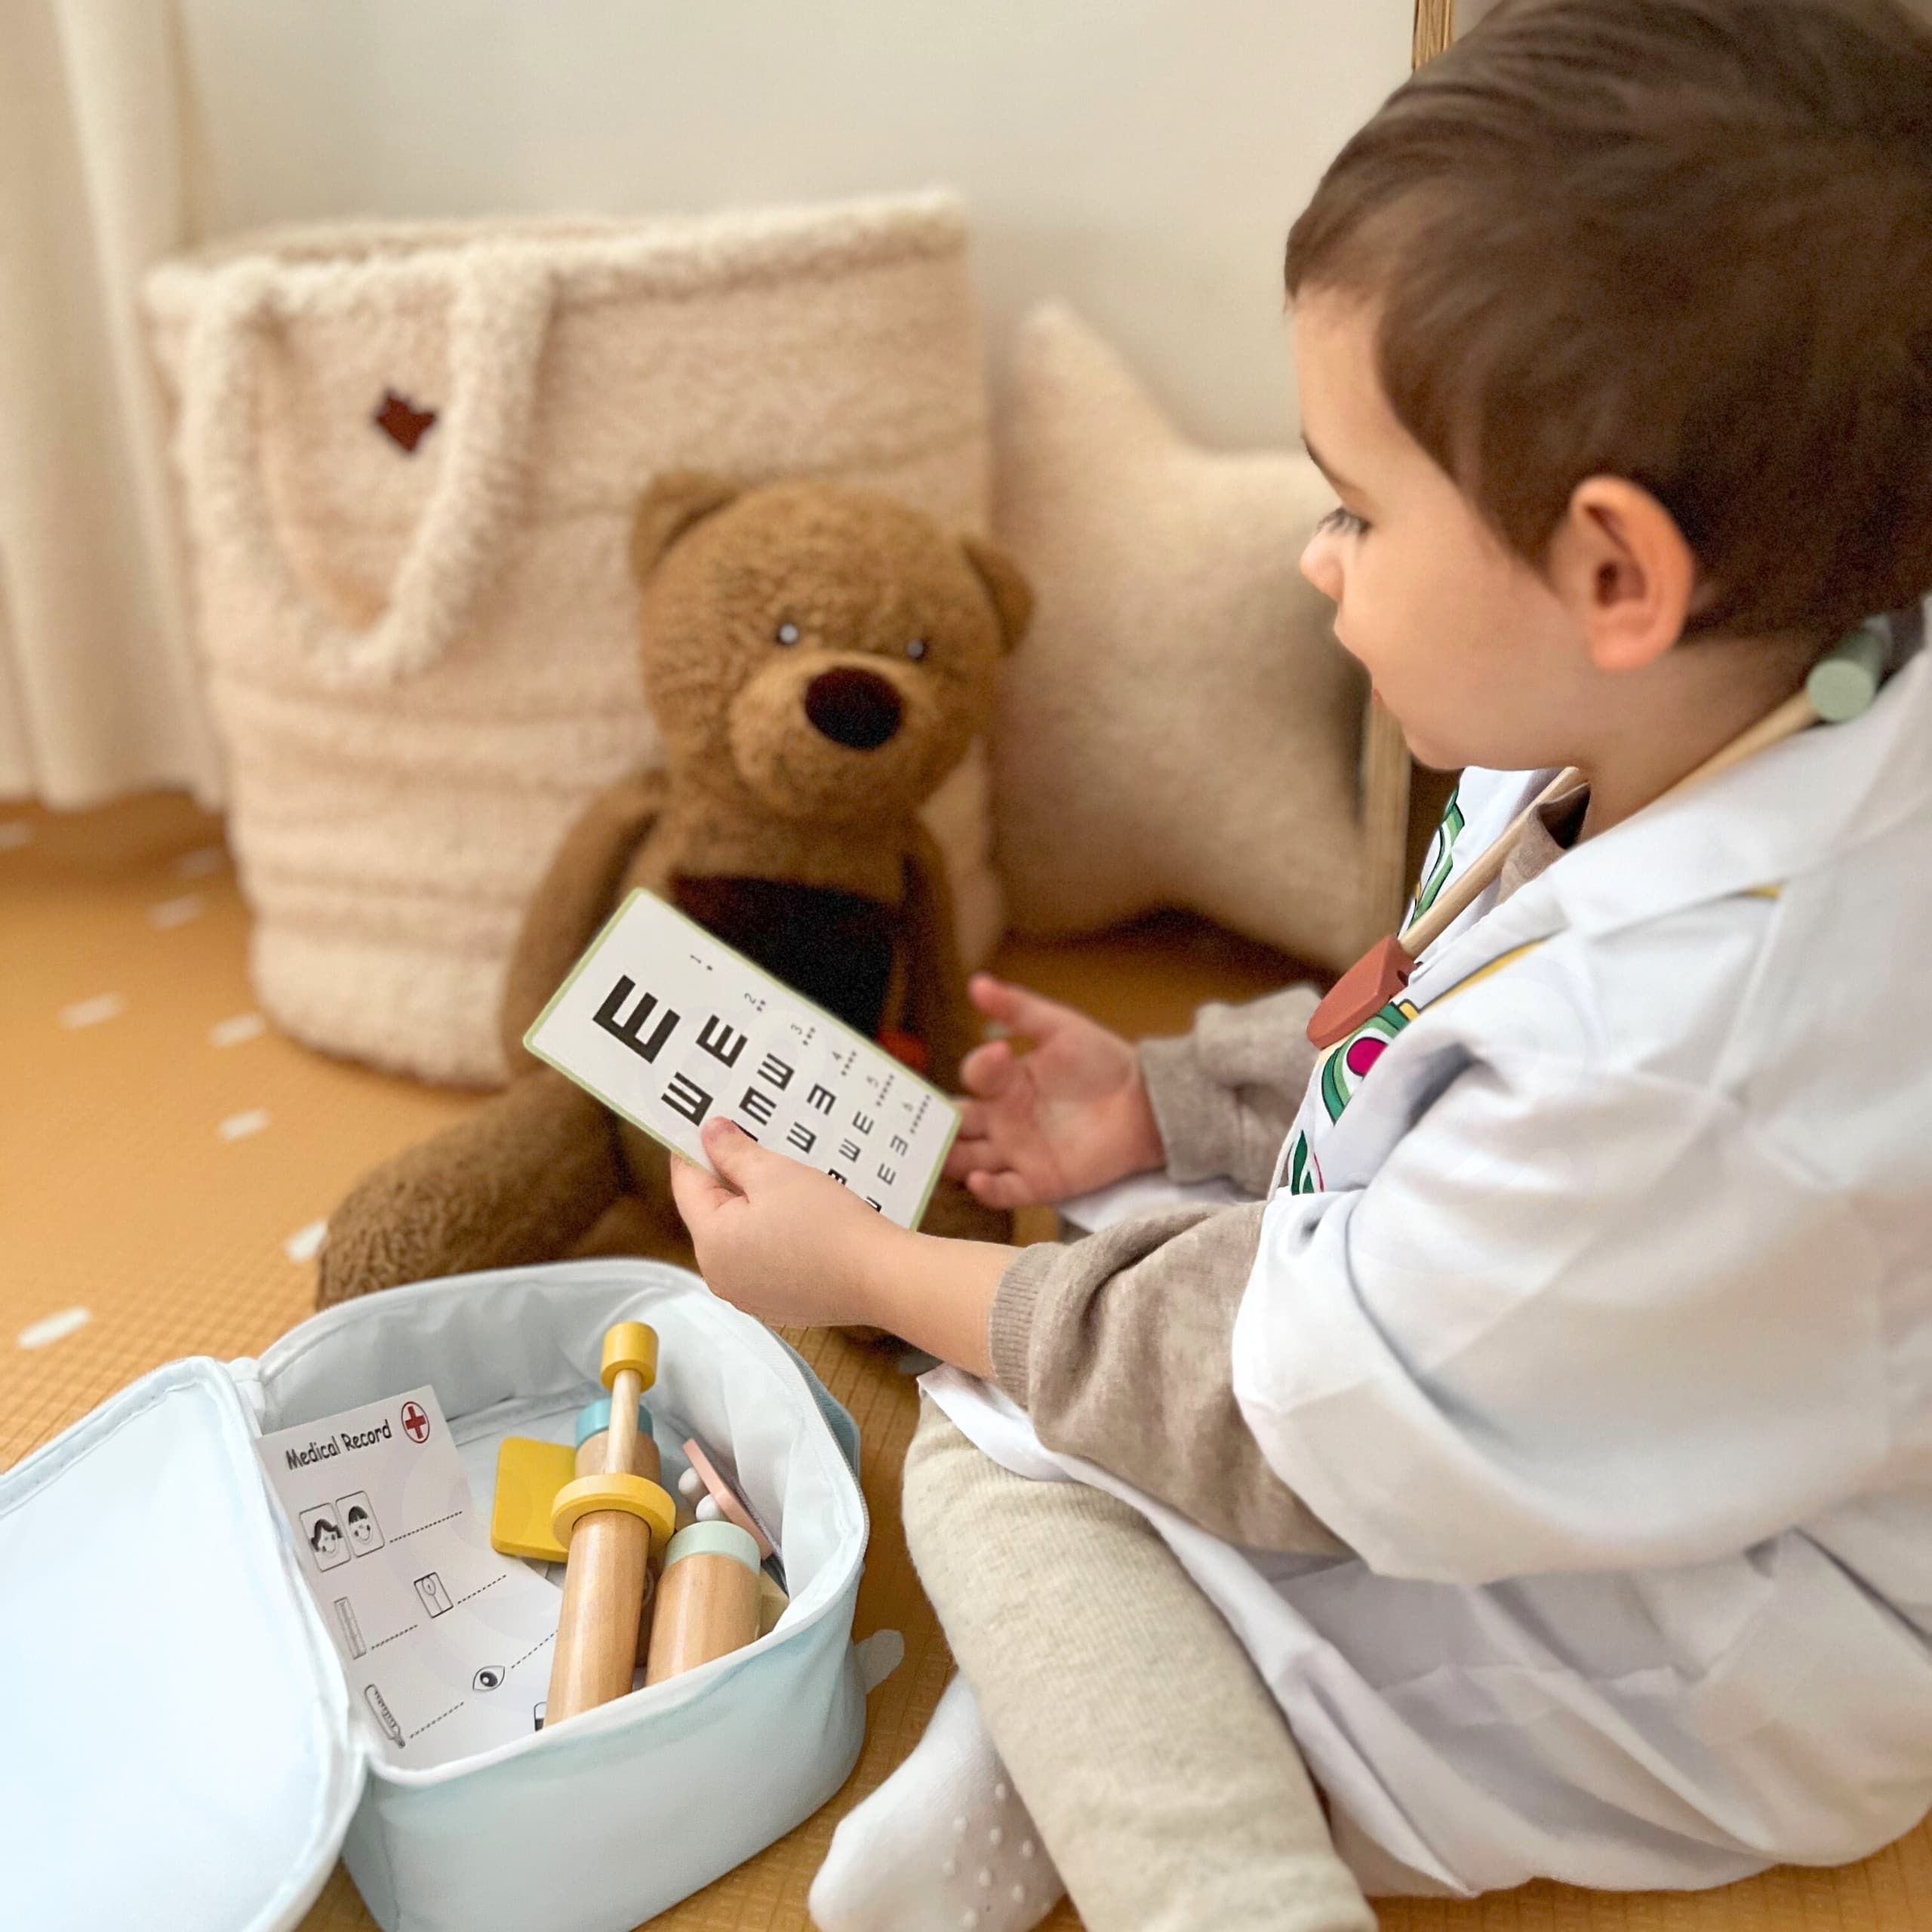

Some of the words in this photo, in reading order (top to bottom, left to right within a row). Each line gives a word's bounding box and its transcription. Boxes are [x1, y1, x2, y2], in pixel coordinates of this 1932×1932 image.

[592, 974, 681, 1064] E
[696, 1014, 748, 1069] E
[285, 1435, 341, 1470] Medical
[340, 1418, 392, 1451] Record
